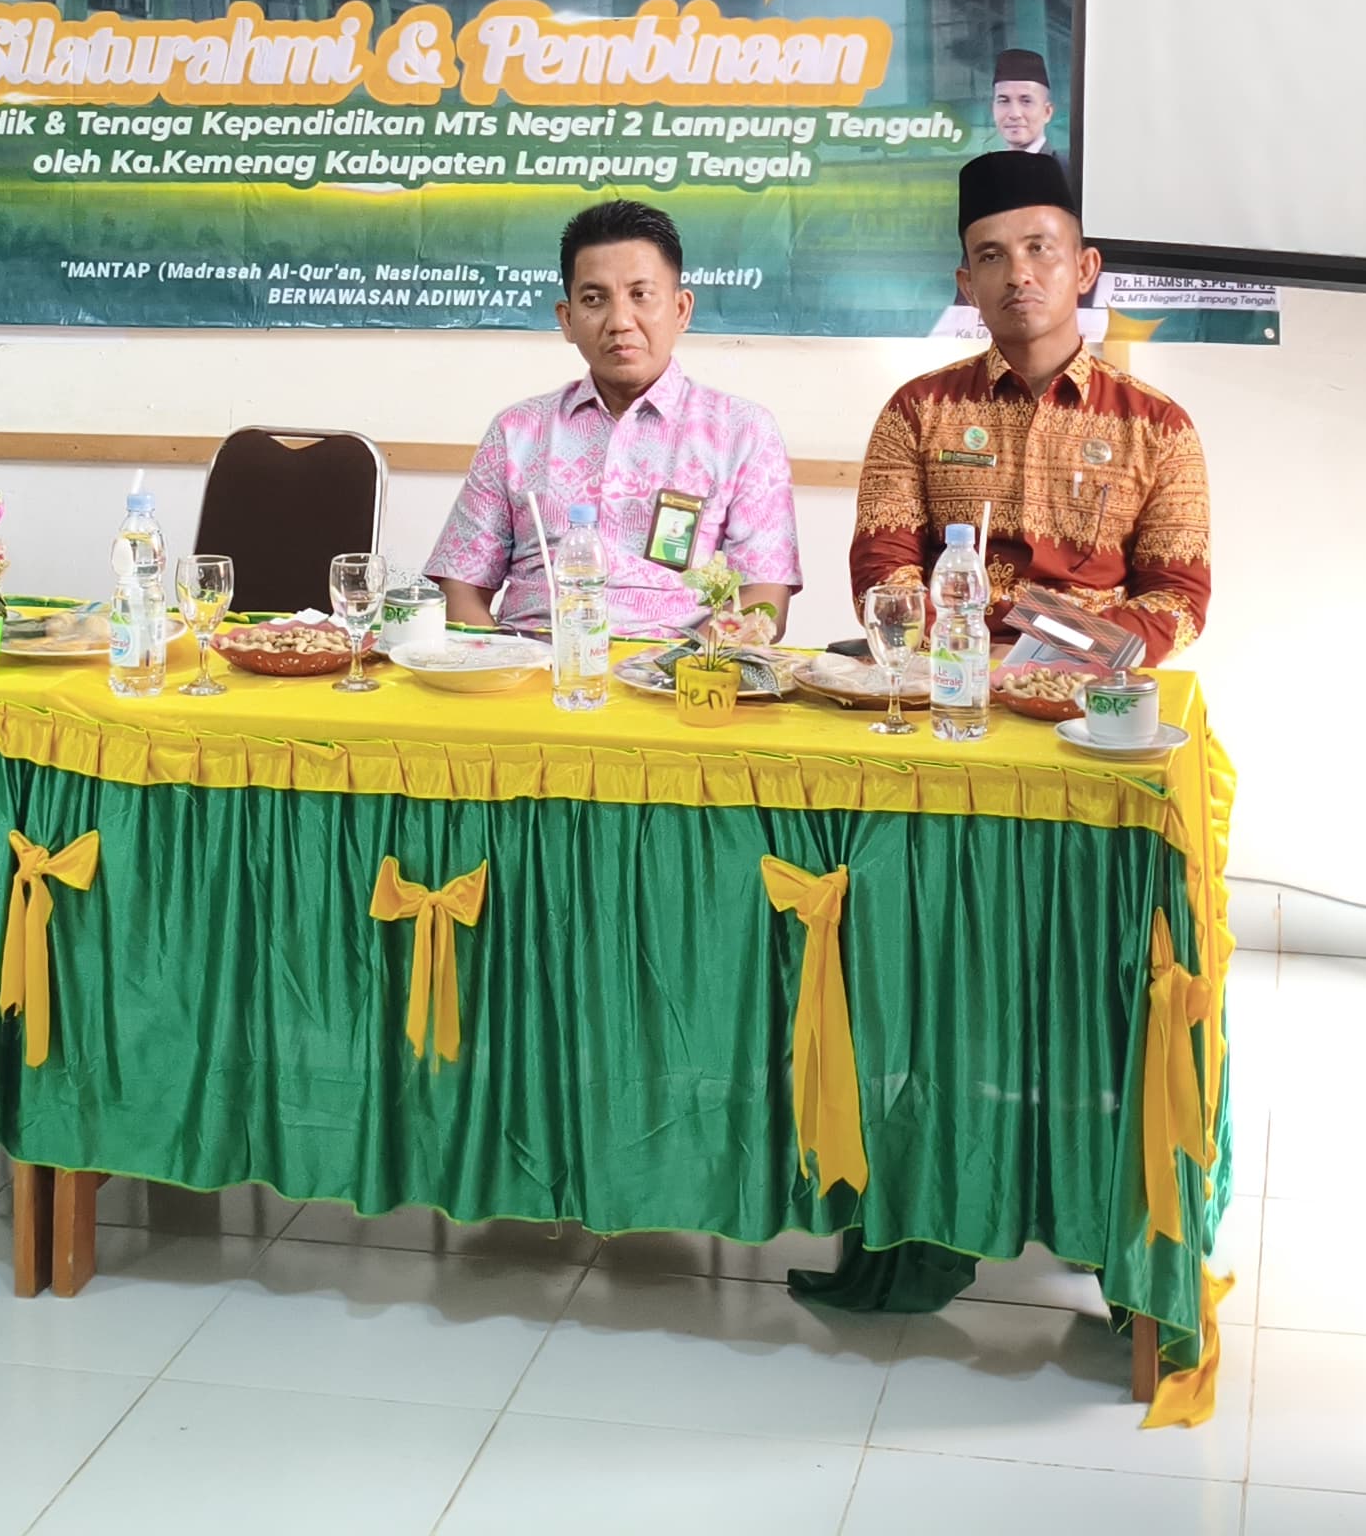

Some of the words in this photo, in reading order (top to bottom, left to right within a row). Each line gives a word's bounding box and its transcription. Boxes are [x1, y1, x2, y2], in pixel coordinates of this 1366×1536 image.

[386, 20, 445, 85] &
[478, 15, 868, 85] Pembinaan
[44, 112, 67, 136] &
[78, 111, 193, 141] Tenaga
[202, 110, 425, 143] Kependidikan
[435, 111, 498, 136] MTs
[507, 109, 615, 143] Negeri
[622, 111, 642, 136] 2
[652, 111, 817, 144] Lampung
[826, 111, 963, 145] Tengah,
[33, 149, 101, 175] oleh
[111, 150, 316, 182] Ka.Kemenag
[325, 150, 507, 183] Kabupaten
[515, 150, 677, 183] Lampung
[687, 151, 812, 184] Tengah
[61, 261, 150, 278] "MANTAP
[158, 262, 261, 282] (Madrasah
[268, 263, 367, 283] Al-Qur'an,
[375, 265, 485, 284] Nasionalis,
[495, 266, 564, 285] Taqwa,
[680, 268, 763, 290] oduktif)
[1115, 277, 1130, 288] Dr.
[1134, 277, 1145, 288] H.
[1148, 277, 1197, 289] HAMSIR,
[267, 287, 415, 306] BERWAWASAN
[416, 290, 542, 307] ADIWIYATA"
[1128, 293, 1147, 302] MTs
[1151, 294, 1183, 304] Negeri
[1184, 294, 1191, 303] 2
[1192, 294, 1238, 305] Lampung
[1240, 296, 1275, 306] Tengah
[677, 677, 733, 710] Heni
